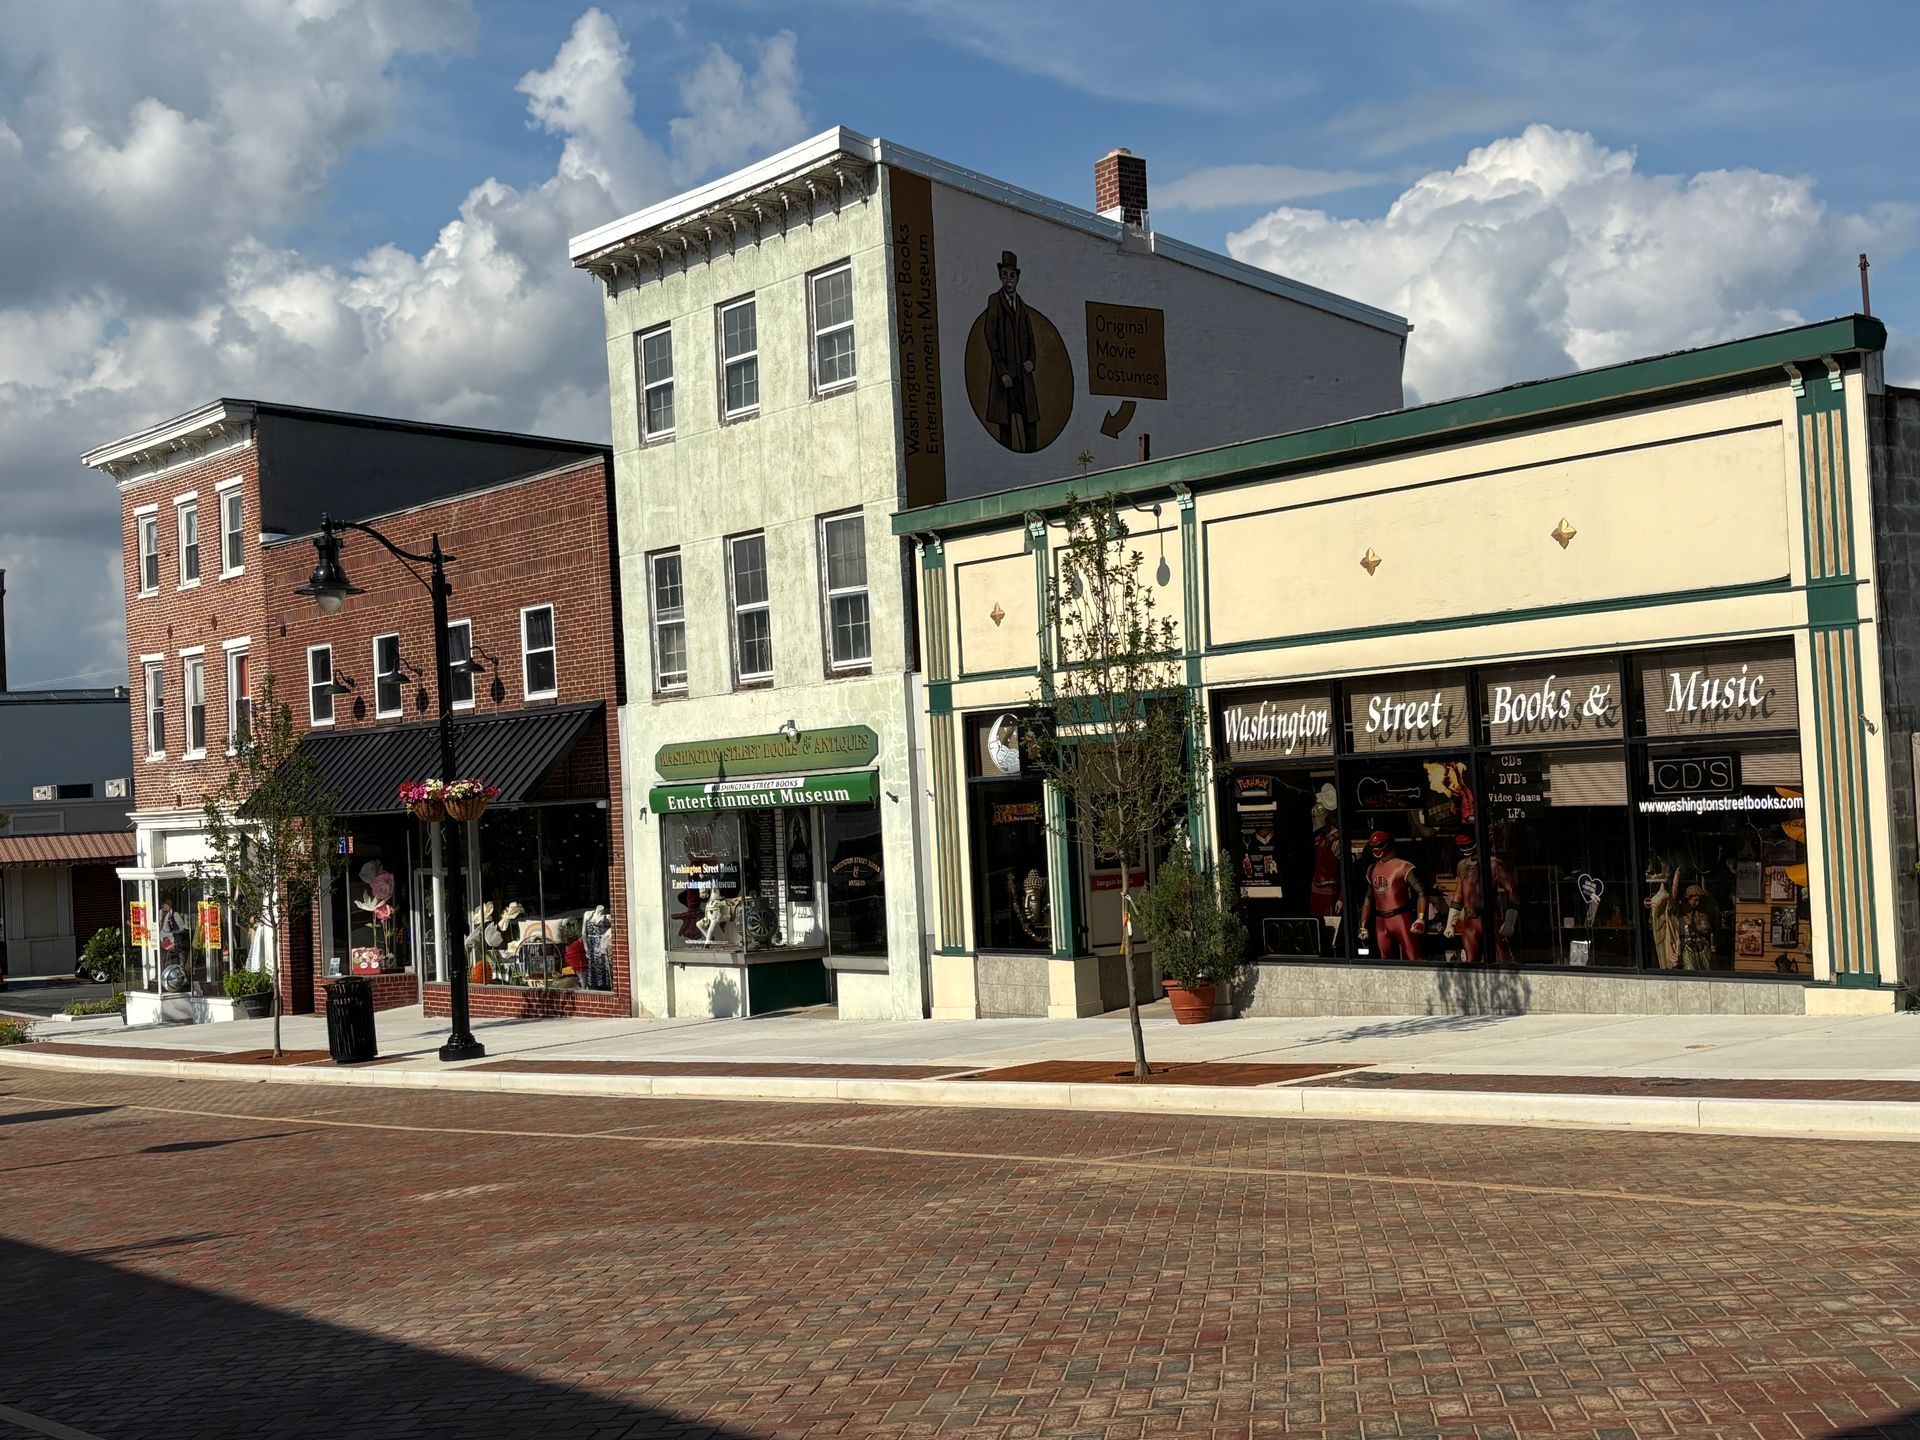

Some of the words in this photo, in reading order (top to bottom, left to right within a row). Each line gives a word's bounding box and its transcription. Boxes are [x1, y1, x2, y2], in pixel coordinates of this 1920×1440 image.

[897, 223, 912, 284] Books
[917, 233, 932, 320] Museum
[901, 293, 914, 346] Street
[1095, 314, 1149, 339] Original
[1096, 339, 1137, 359] Movie
[1096, 363, 1160, 386] Costumes
[920, 324, 939, 455] Entertainment
[902, 351, 920, 457] Washington
[1223, 700, 1329, 755] Washington
[1365, 693, 1444, 733] Street
[1491, 675, 1572, 724] Books
[1583, 684, 1611, 717] &
[1665, 664, 1765, 713] Music
[659, 748, 721, 767] WASHINGTON
[722, 744, 761, 762] STREET
[763, 740, 798, 758] BOOKS
[814, 734, 870, 754] ANTIQUES
[1501, 755, 1522, 767] CD's
[711, 782, 751, 792] WASHINGTON
[752, 781, 774, 790] STREET
[775, 779, 799, 788] BOOKS
[1498, 773, 1527, 785] DVD's
[1658, 760, 1729, 789] CD'S
[668, 792, 777, 811] Entertainment
[779, 787, 850, 806] Museum
[1488, 793, 1512, 802] Video
[1515, 793, 1541, 802] Games
[1638, 795, 1804, 815] www.washingtonstreetbooks.com
[669, 863, 701, 876] Washington
[702, 863, 719, 874] Street
[720, 863, 738, 873] Books
[672, 880, 711, 890] Entertainment
[712, 880, 737, 889] Museum
